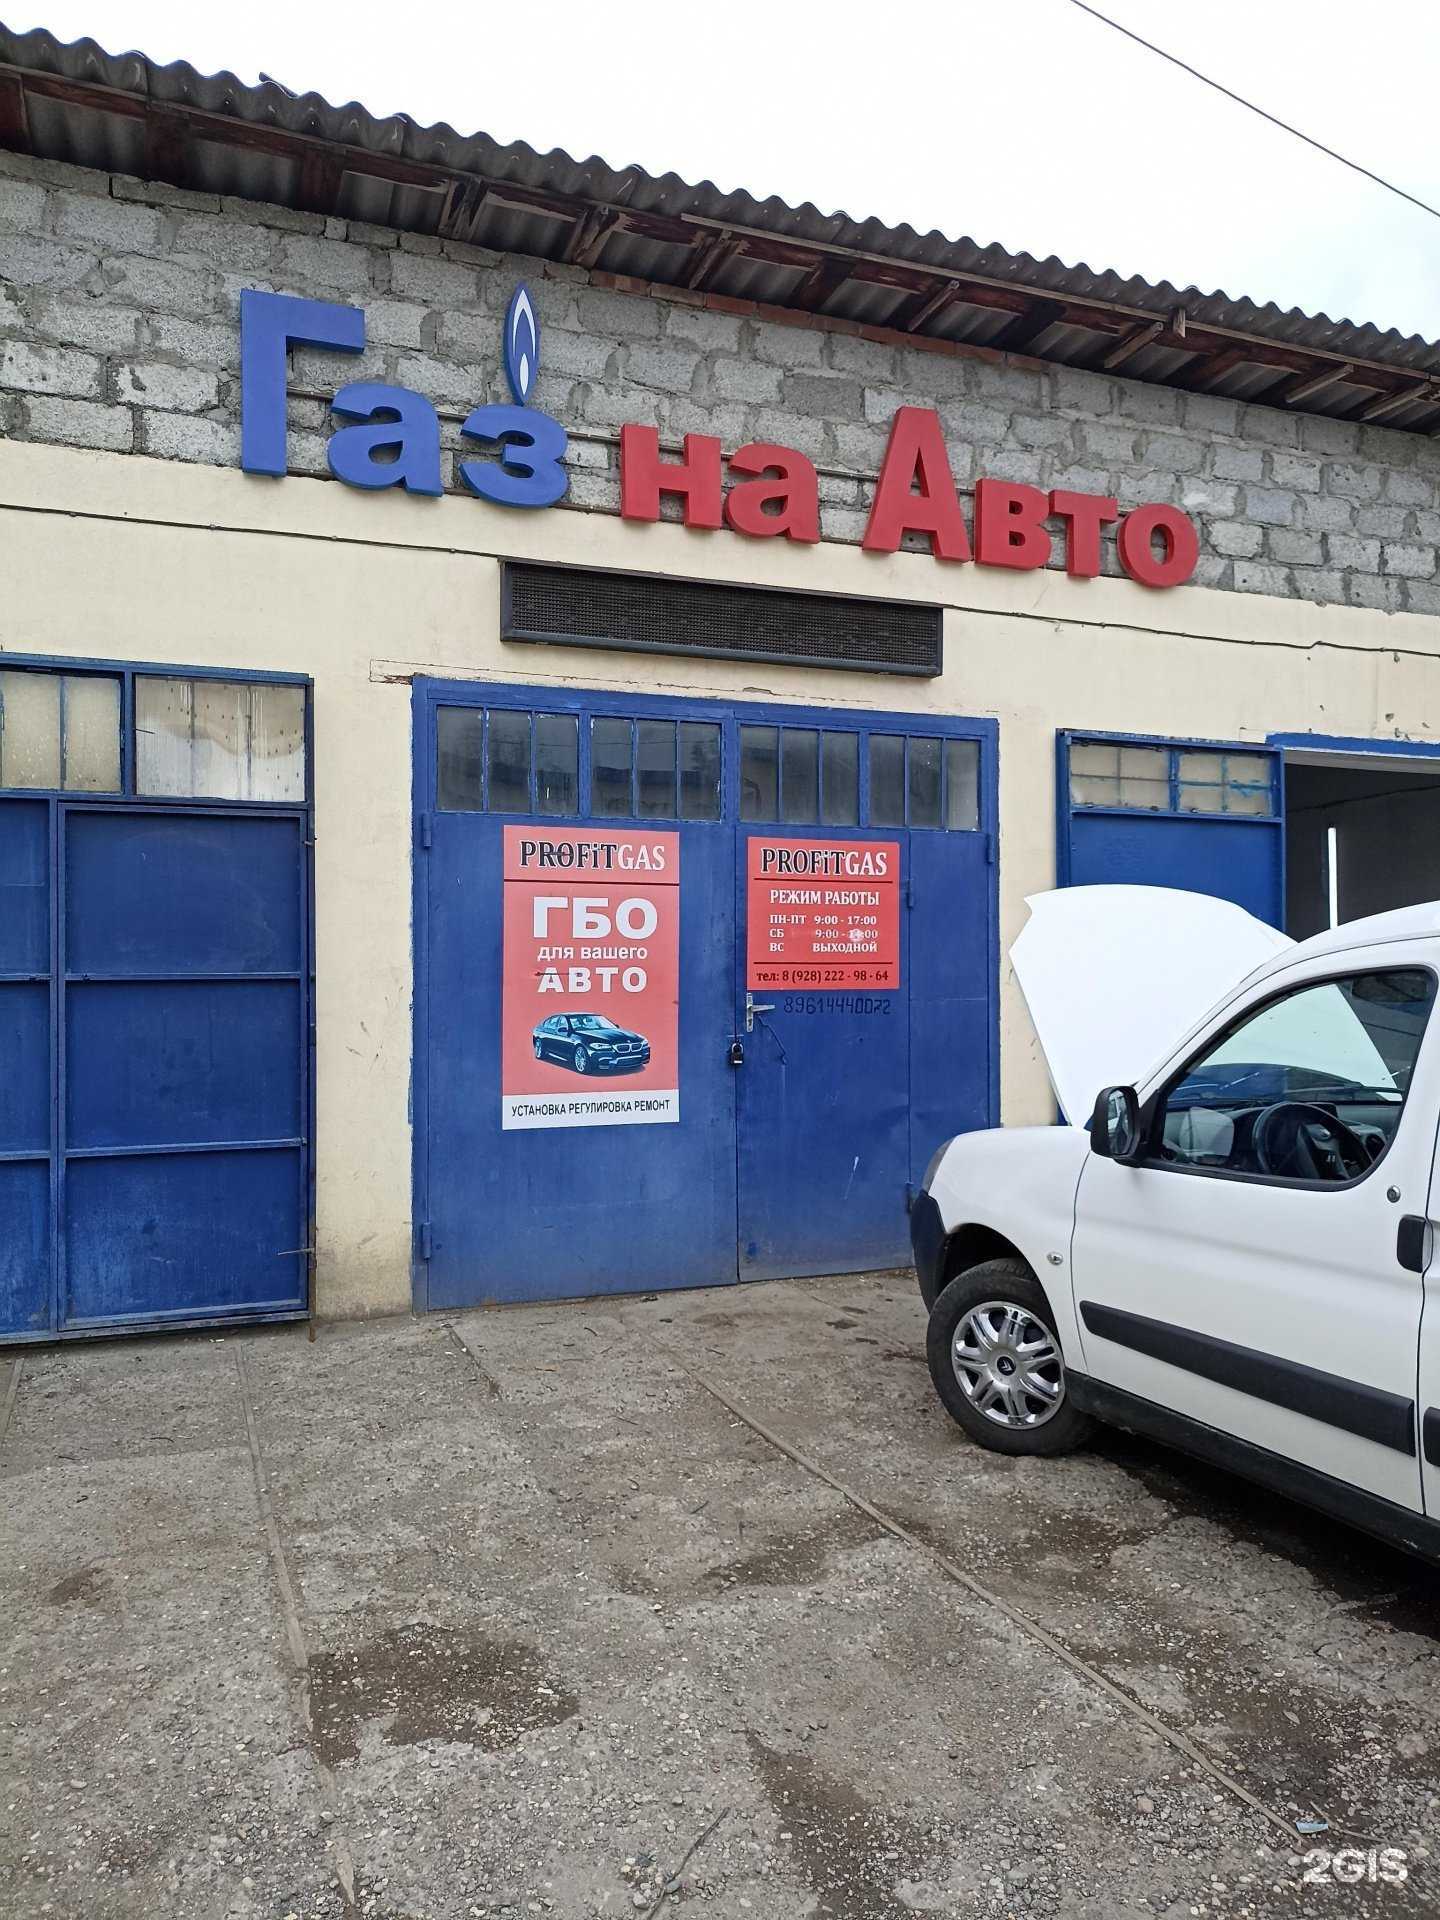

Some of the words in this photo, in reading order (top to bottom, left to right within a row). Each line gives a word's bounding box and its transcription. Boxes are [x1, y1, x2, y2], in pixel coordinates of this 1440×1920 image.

[240, 289, 570, 510] Газ
[620, 423, 820, 545] на
[862, 406, 1199, 588] Авто
[770, 889, 821, 904] РЕЖИМ
[825, 891, 880, 905] РАБОТЫ
[533, 896, 658, 939] ГБО
[769, 915, 806, 924] ПН-ПТ
[814, 916, 838, 925] 9:00
[848, 916, 877, 925] 17:00
[769, 929, 784, 938] СБ
[815, 930, 839, 939] 9:00
[537, 947, 574, 961] для
[580, 947, 648, 960] вашего
[769, 943, 784, 952] ВС
[813, 941, 878, 953] ВЫХОДНОЙ
[537, 966, 648, 993] АВТО
[757, 971, 780, 982] тел:
[782, 970, 789, 981] 8
[792, 970, 821, 983] (928)
[824, 970, 844, 981] 222
[853, 971, 867, 981] 98
[875, 970, 889, 981] 64
[512, 1104, 566, 1117] УСТАНОВКА
[569, 1101, 632, 1114] РЕГУЛИРОВКА
[634, 1099, 671, 1111] РЕМОНТ
